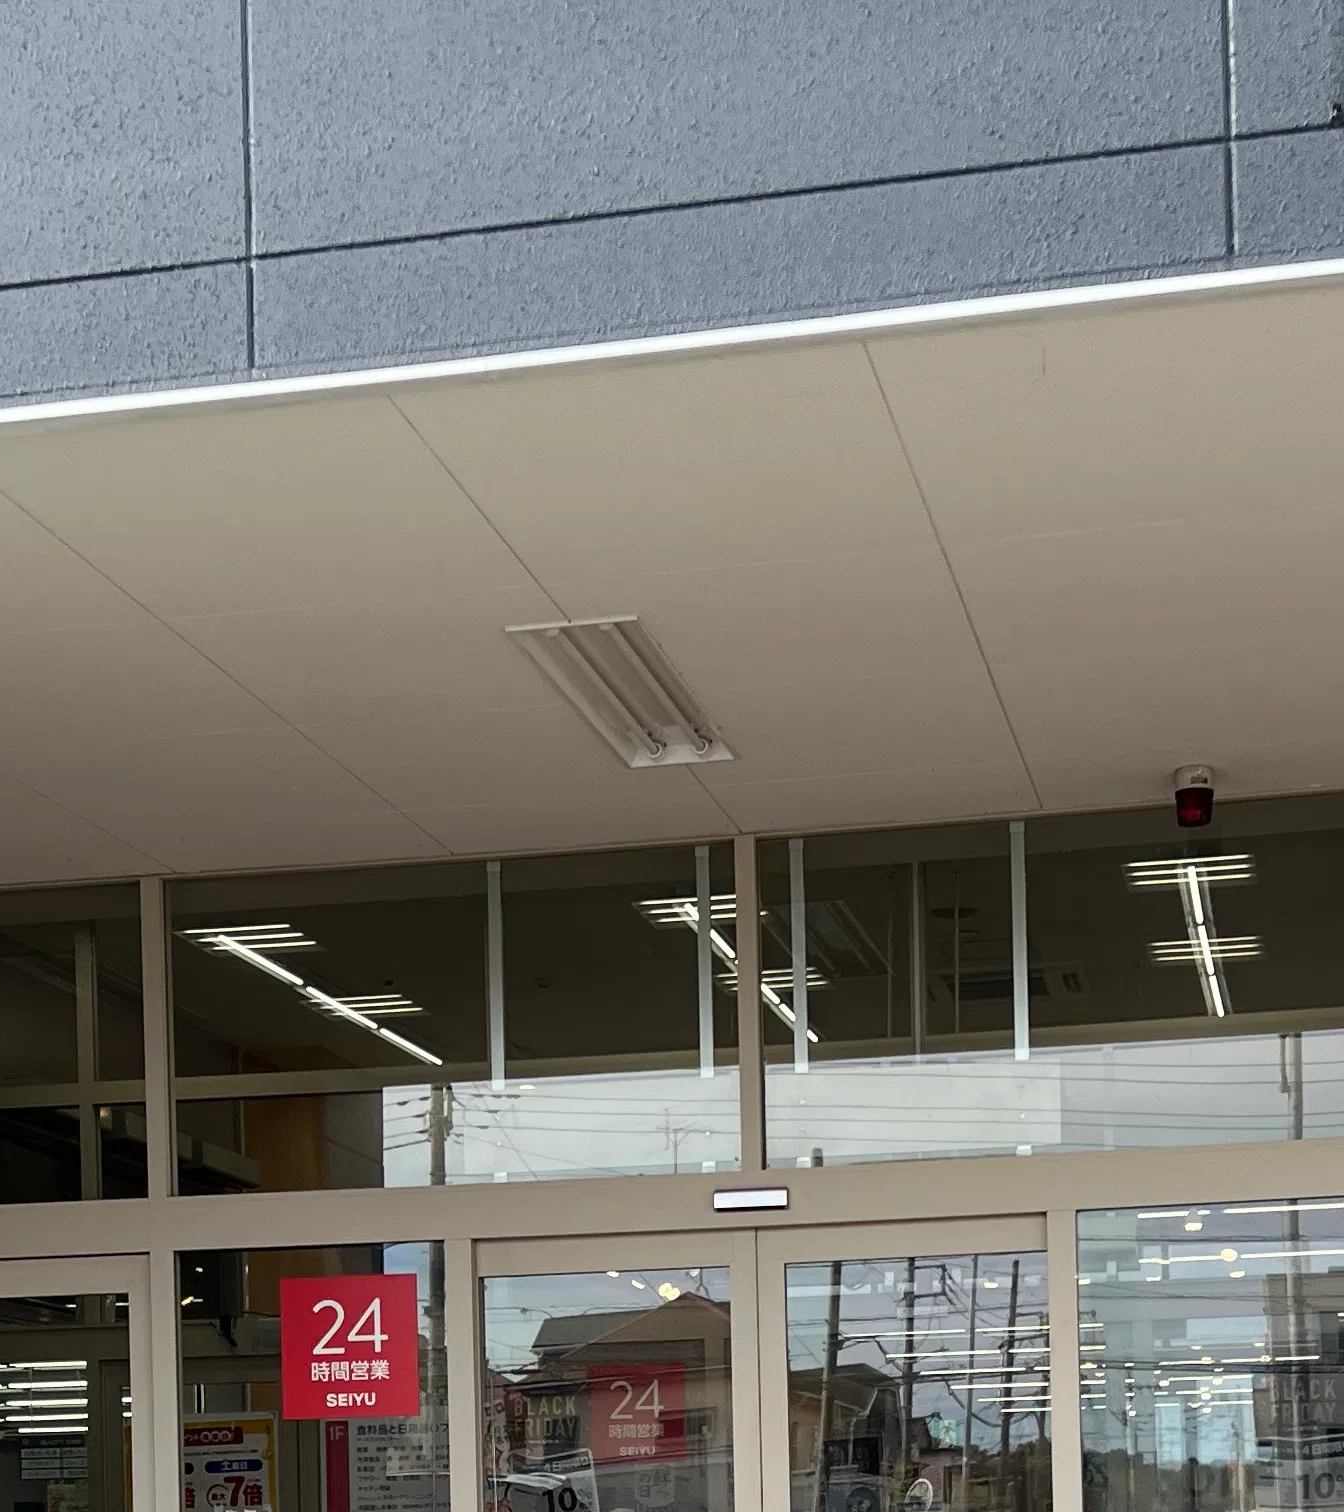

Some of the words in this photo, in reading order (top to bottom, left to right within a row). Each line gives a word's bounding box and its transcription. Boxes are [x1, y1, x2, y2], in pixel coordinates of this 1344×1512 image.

[312, 1297, 389, 1355] 24
[311, 1359, 390, 1382] 時間営業
[326, 1392, 376, 1408] SEIYU
[513, 1395, 576, 1416] BLACK
[609, 1379, 665, 1420] 24
[1271, 1401, 1336, 1425] FRDAY
[513, 1418, 576, 1440] FRIDAY
[608, 1424, 664, 1438] 時間営業
[619, 1446, 656, 1456] SEIYU
